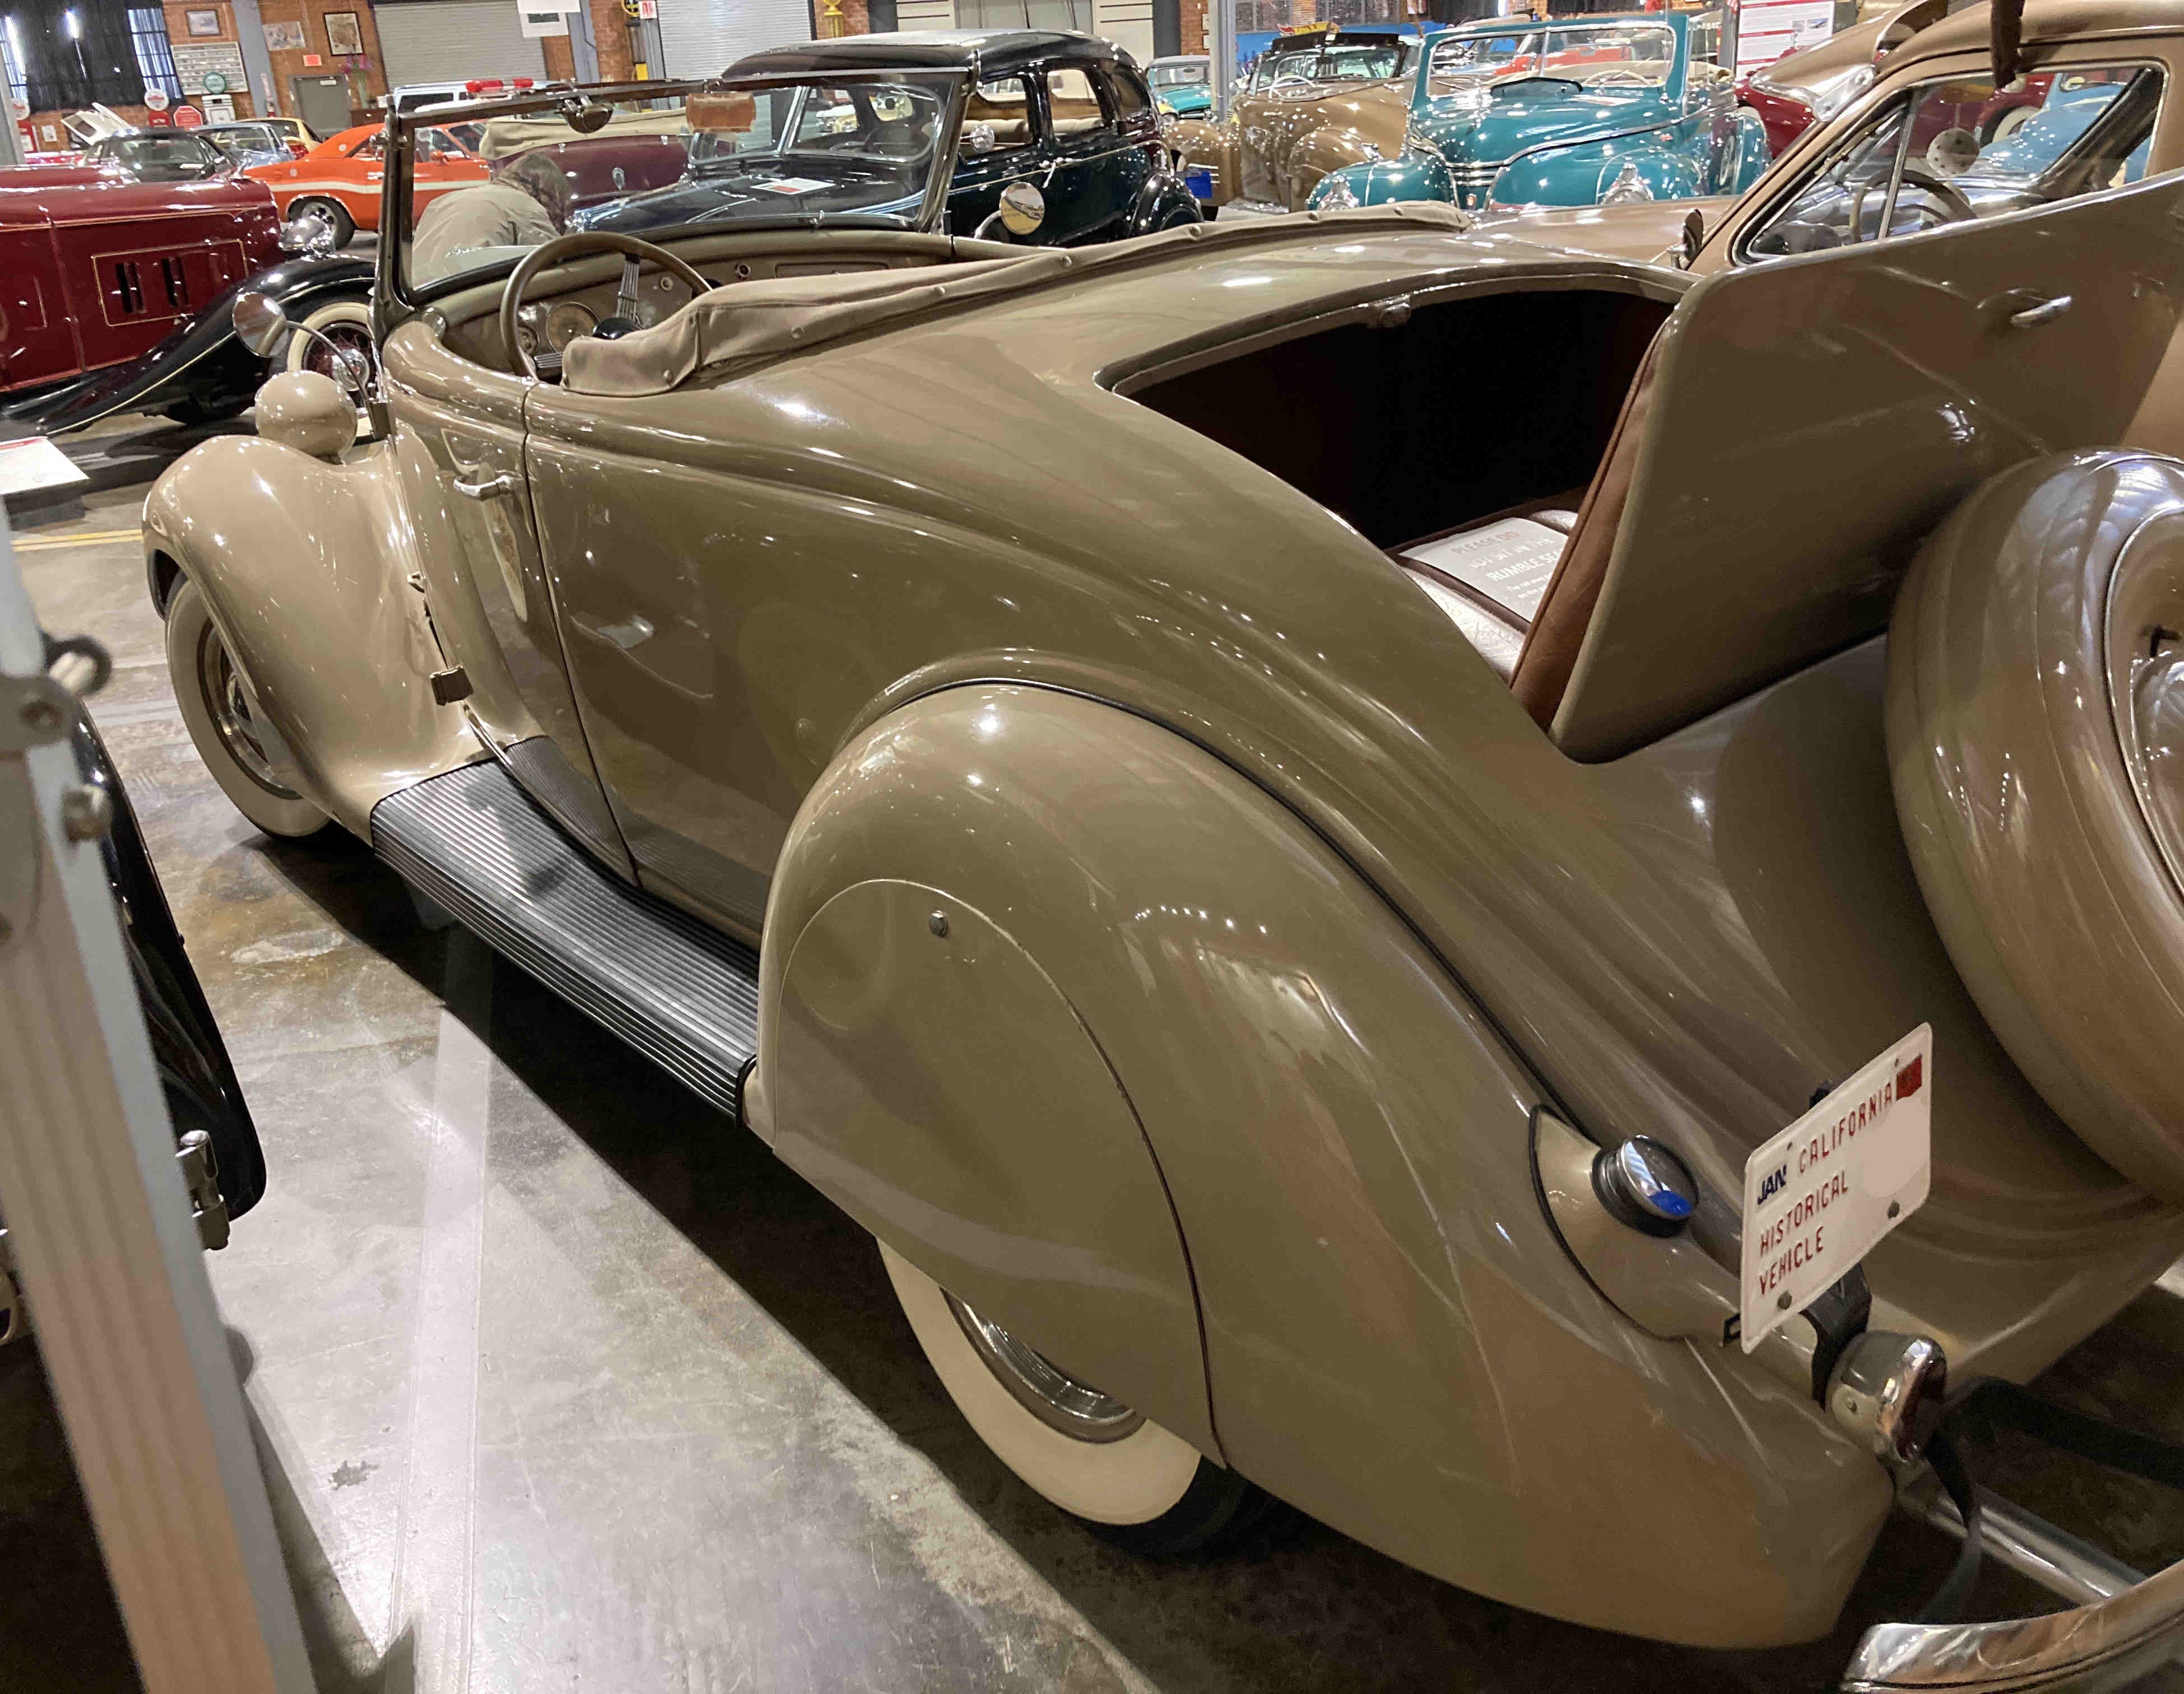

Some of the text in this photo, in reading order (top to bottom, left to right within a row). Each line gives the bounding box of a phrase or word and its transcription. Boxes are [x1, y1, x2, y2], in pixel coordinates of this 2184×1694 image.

[1451, 532, 1519, 555] PLEASE DO
[1466, 555, 1493, 569] NOT
[1491, 548, 1513, 561] SIT
[1486, 558, 1544, 581] RUMBLE
[1799, 1082, 1892, 1174] CALIFORNIA
[1758, 1165, 1787, 1206] JAN
[1760, 1170, 1848, 1258] HISTORICAL
[1759, 1226, 1823, 1295] VEHICLE
